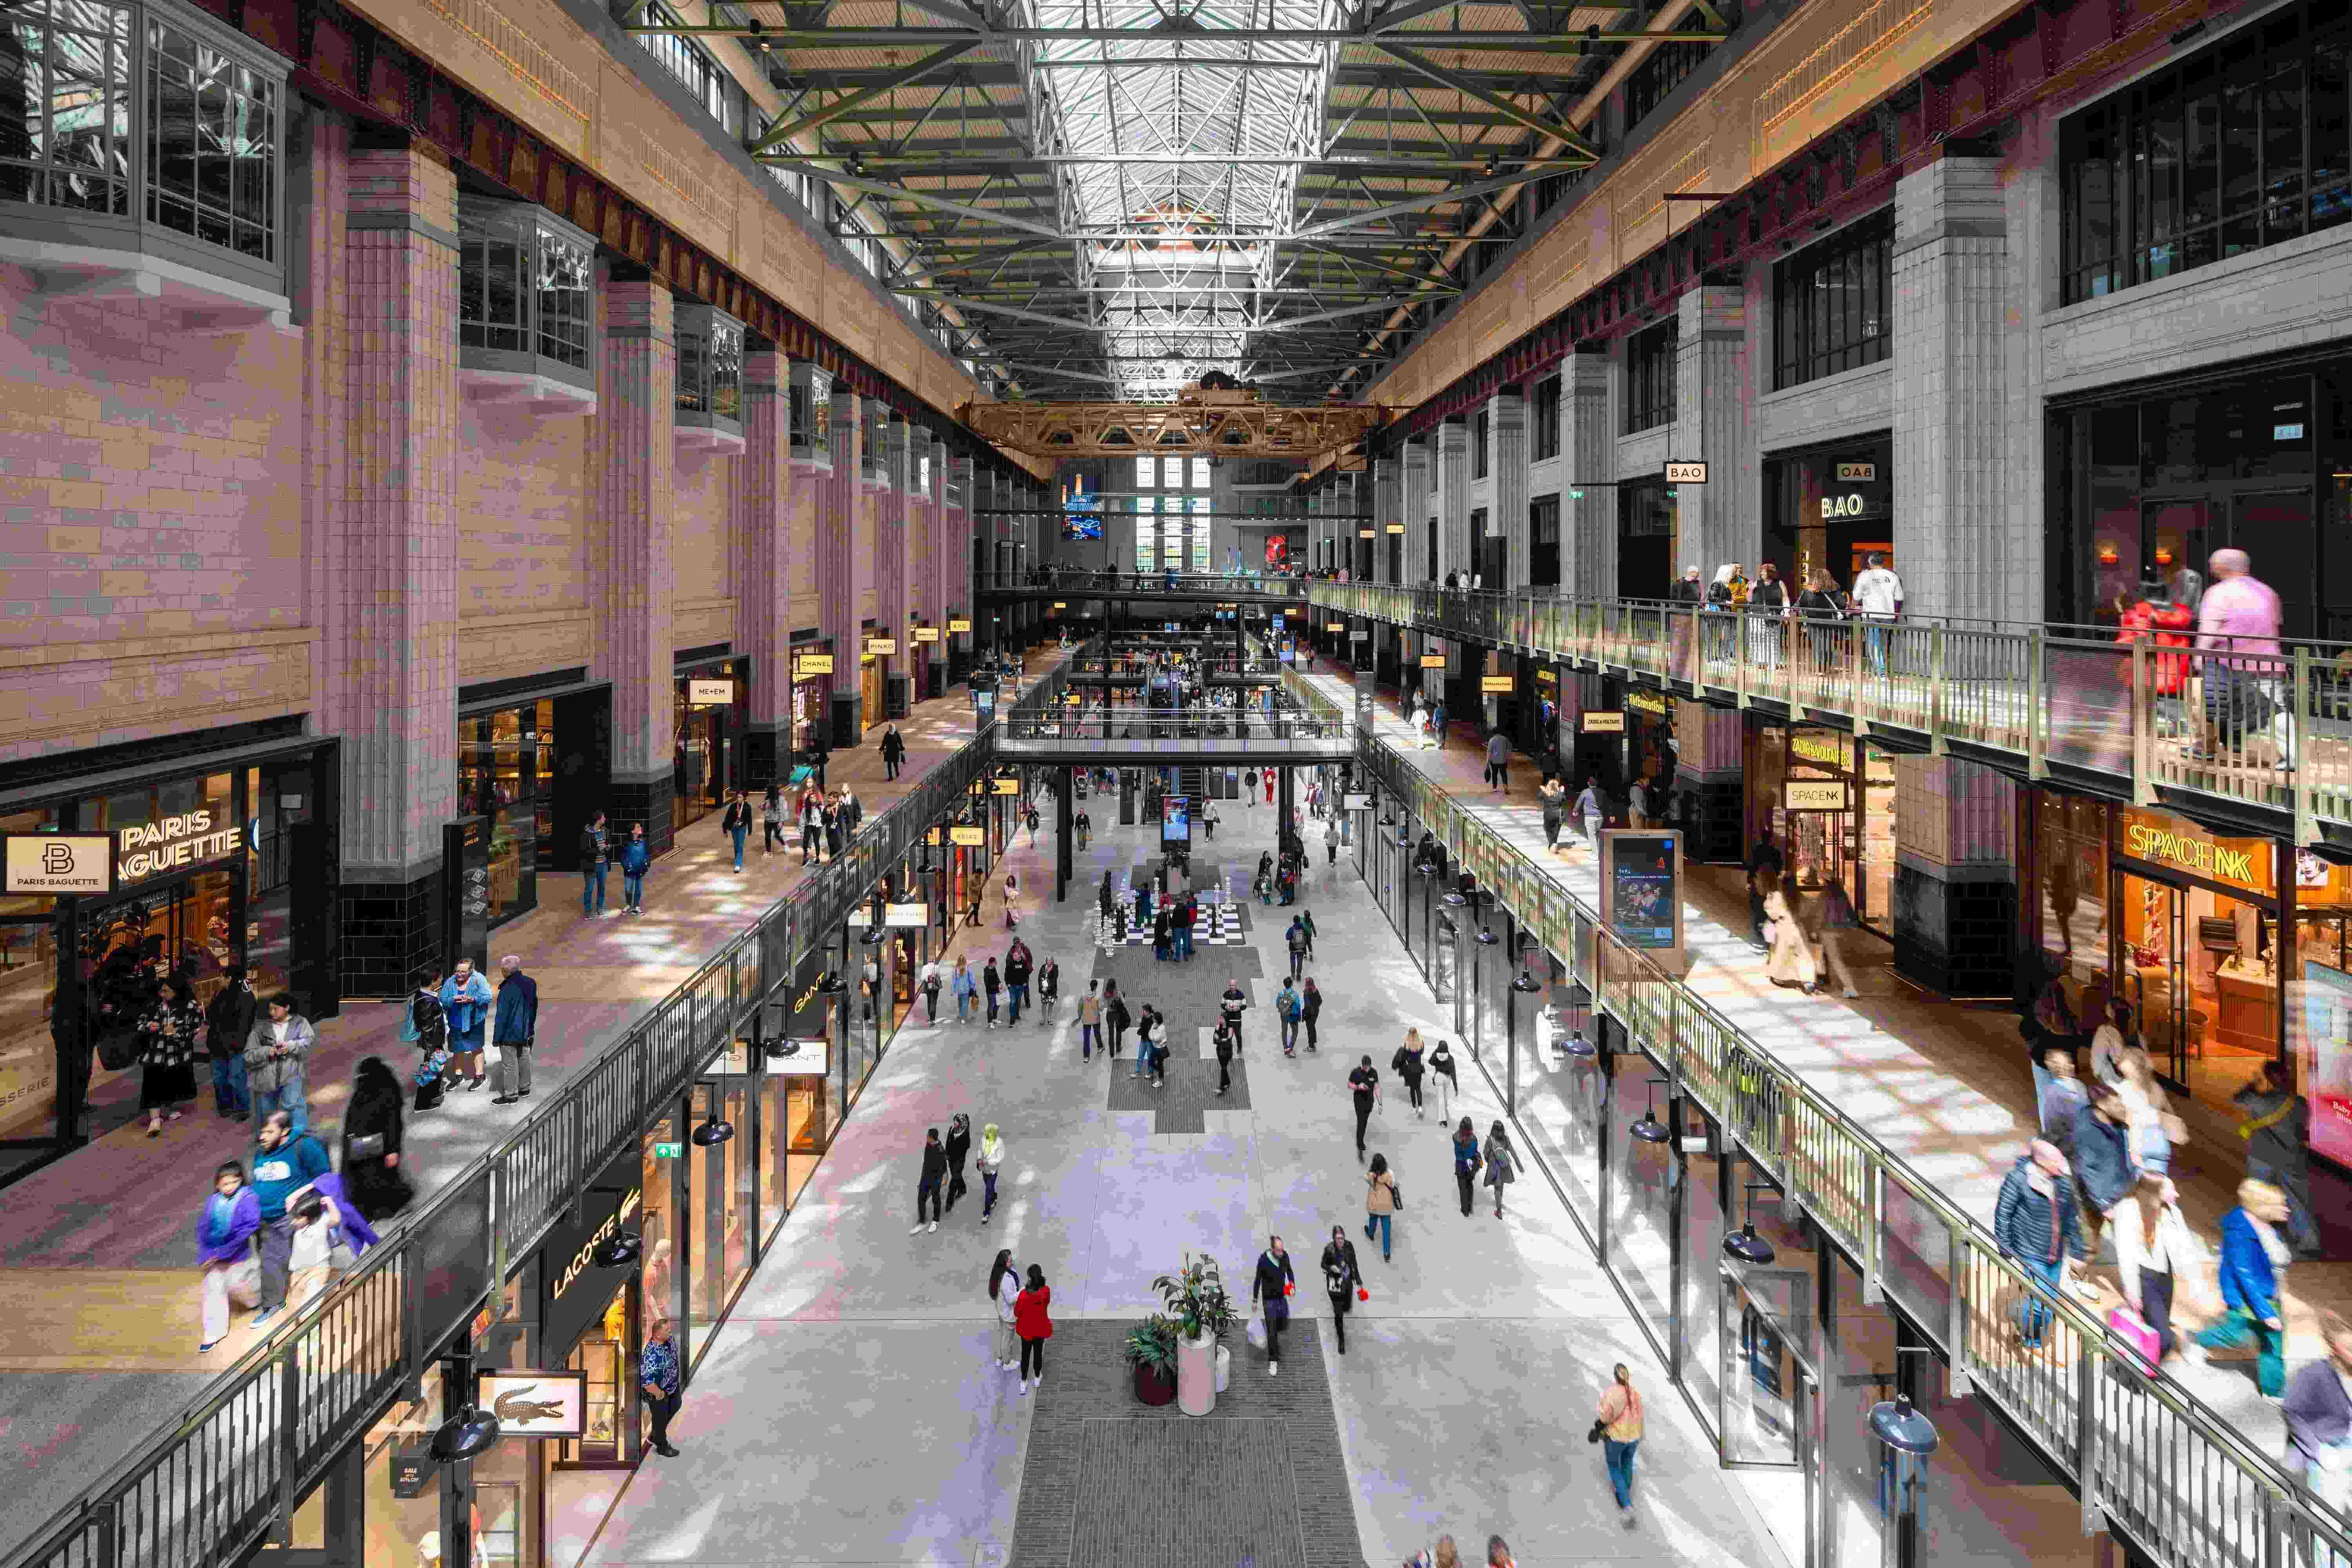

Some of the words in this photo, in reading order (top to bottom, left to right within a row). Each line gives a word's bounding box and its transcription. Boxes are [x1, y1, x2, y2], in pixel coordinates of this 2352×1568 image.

[1671, 468, 1701, 477] BAO
[1821, 494, 1863, 518] BAO
[121, 810, 211, 852] PARIS
[118, 827, 241, 882] AGUETTE
[795, 972, 824, 1013] GANT
[2333, 1100, 2350, 1116] Baby
